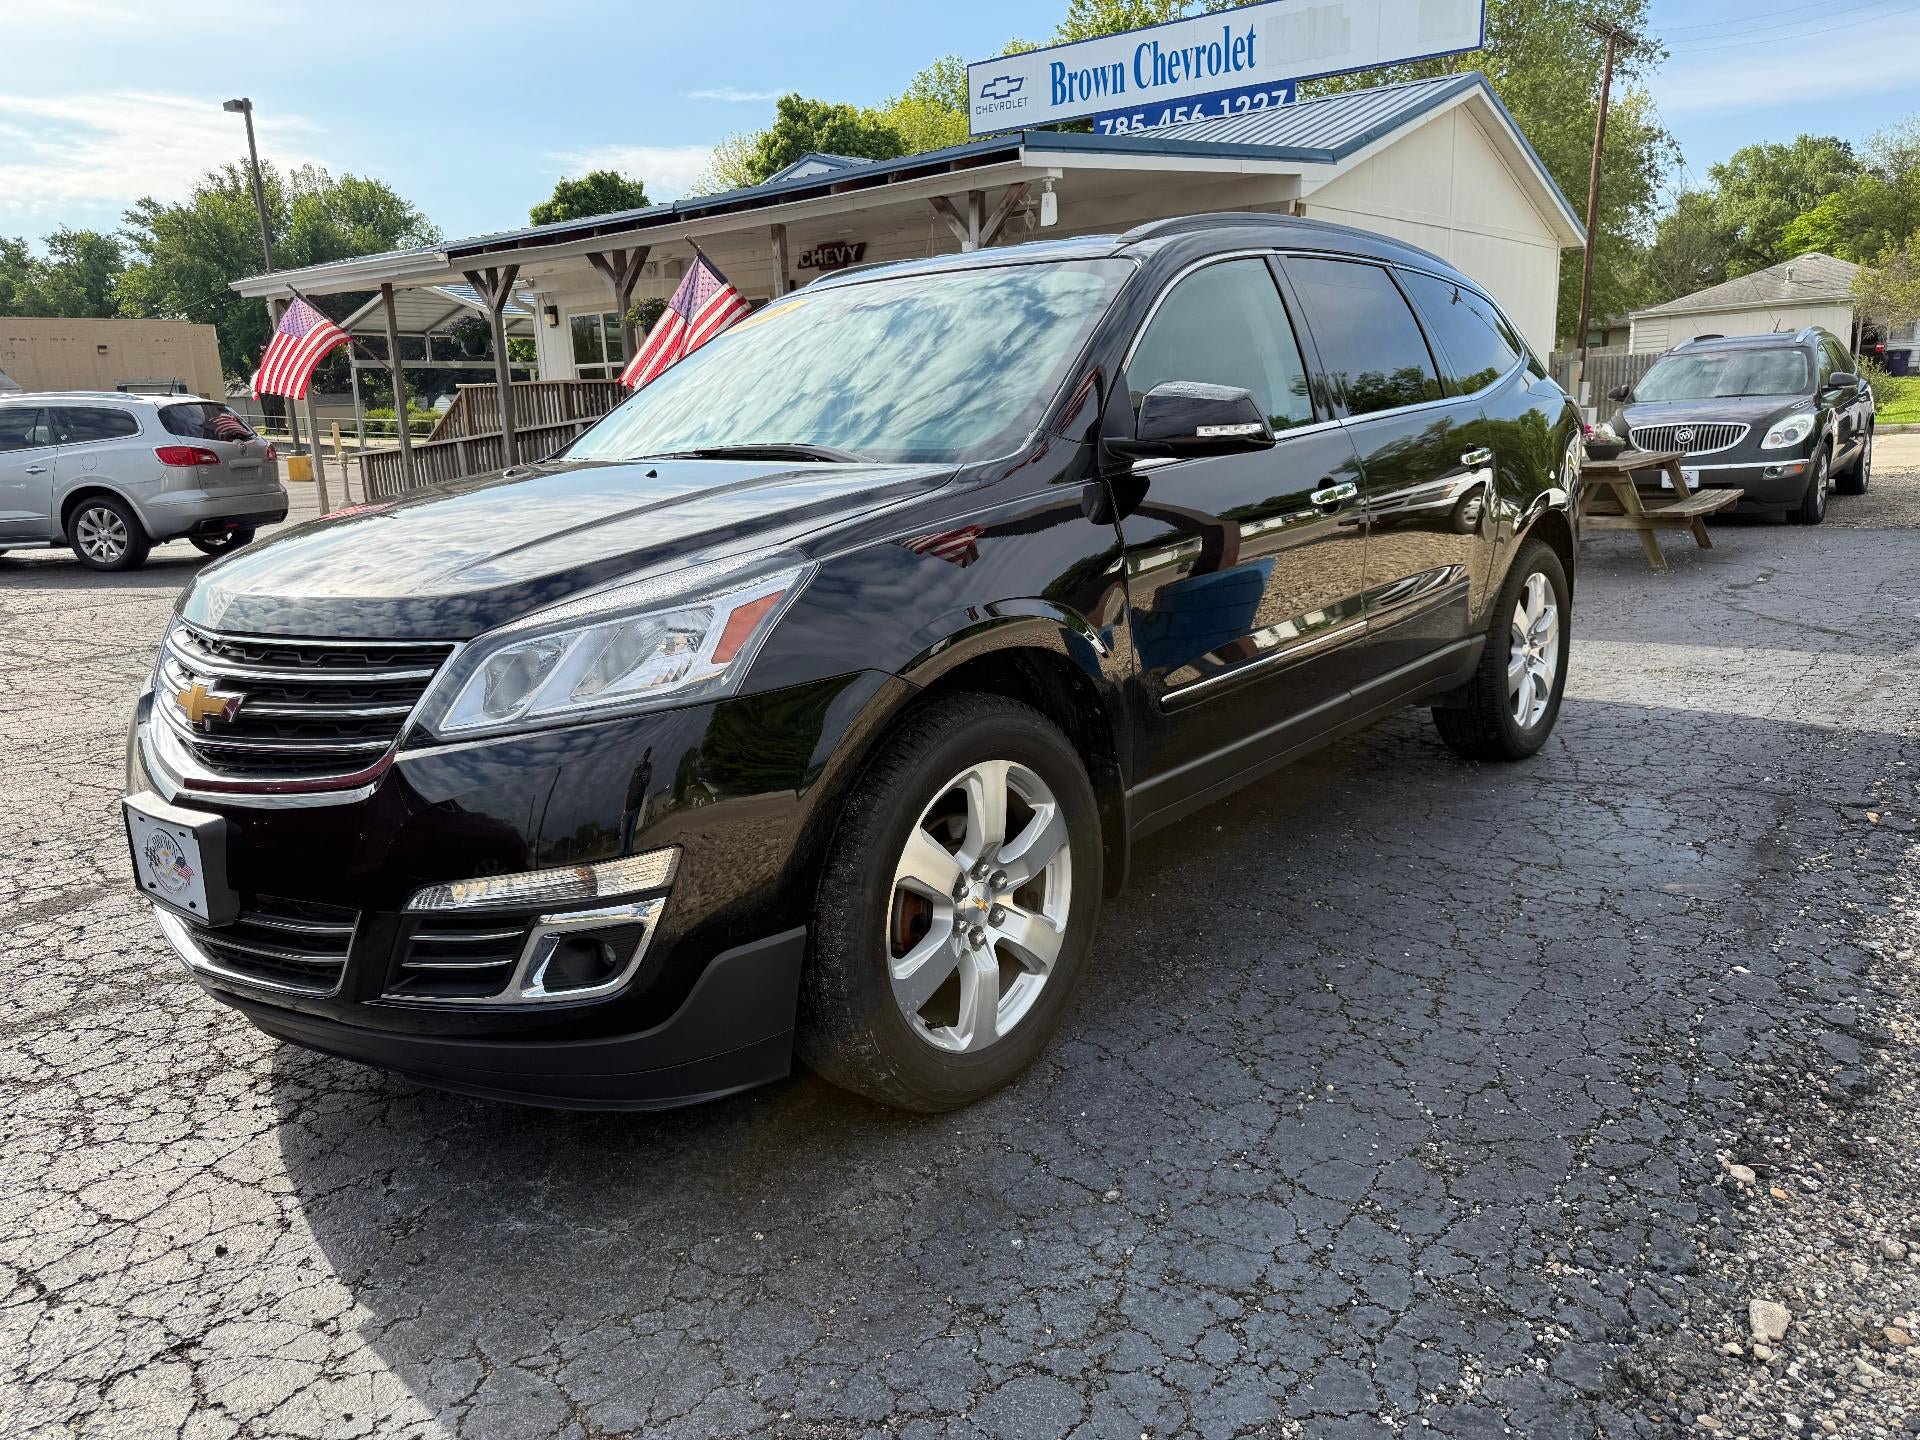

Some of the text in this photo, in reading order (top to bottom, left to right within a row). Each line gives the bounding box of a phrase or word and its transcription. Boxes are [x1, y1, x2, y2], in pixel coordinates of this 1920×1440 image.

[1049, 23, 1257, 106] Brown Chevrolet
[975, 96, 1028, 114] CHEVROLET
[800, 246, 858, 266] CHEVY
